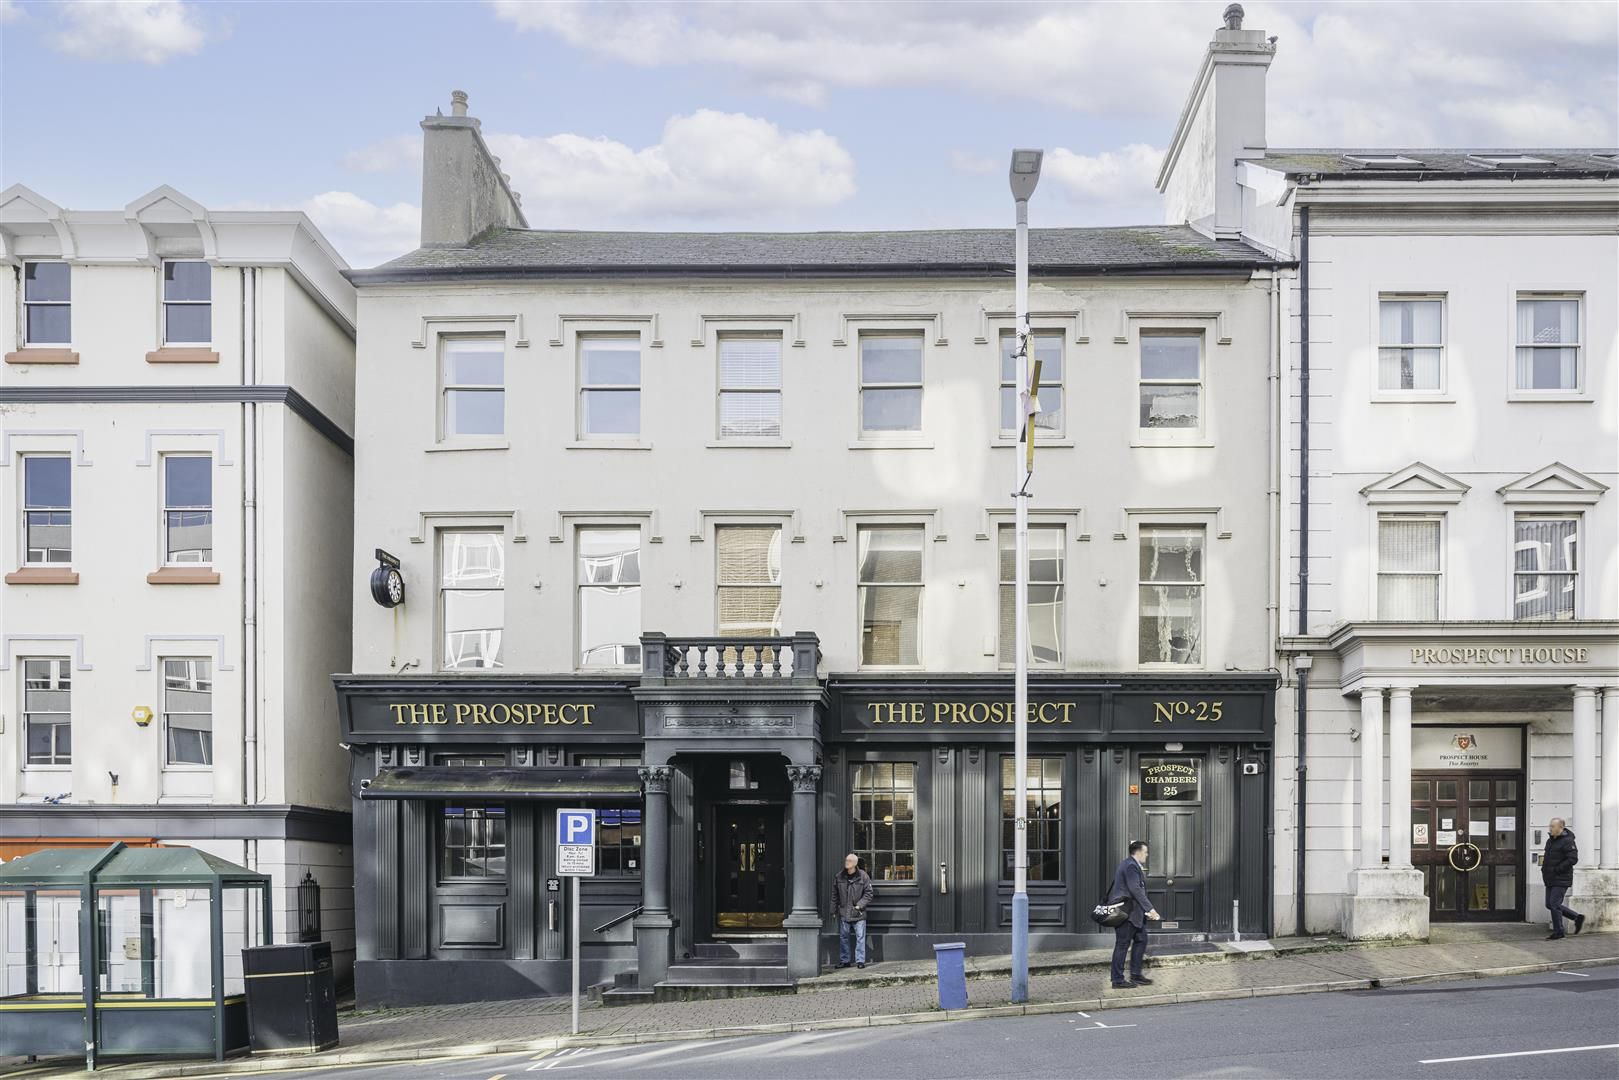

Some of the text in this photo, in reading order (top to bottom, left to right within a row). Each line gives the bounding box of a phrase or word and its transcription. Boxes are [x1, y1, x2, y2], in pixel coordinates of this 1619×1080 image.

[1411, 647, 1588, 664] PROSPECT HOUSE
[389, 703, 596, 725] THE PROSPECT
[867, 702, 926, 724] THE
[1147, 764, 1195, 776] PROSPECT
[1145, 776, 1197, 784] CHAMBERS
[1163, 786, 1178, 796] 25
[567, 815, 589, 842] P
